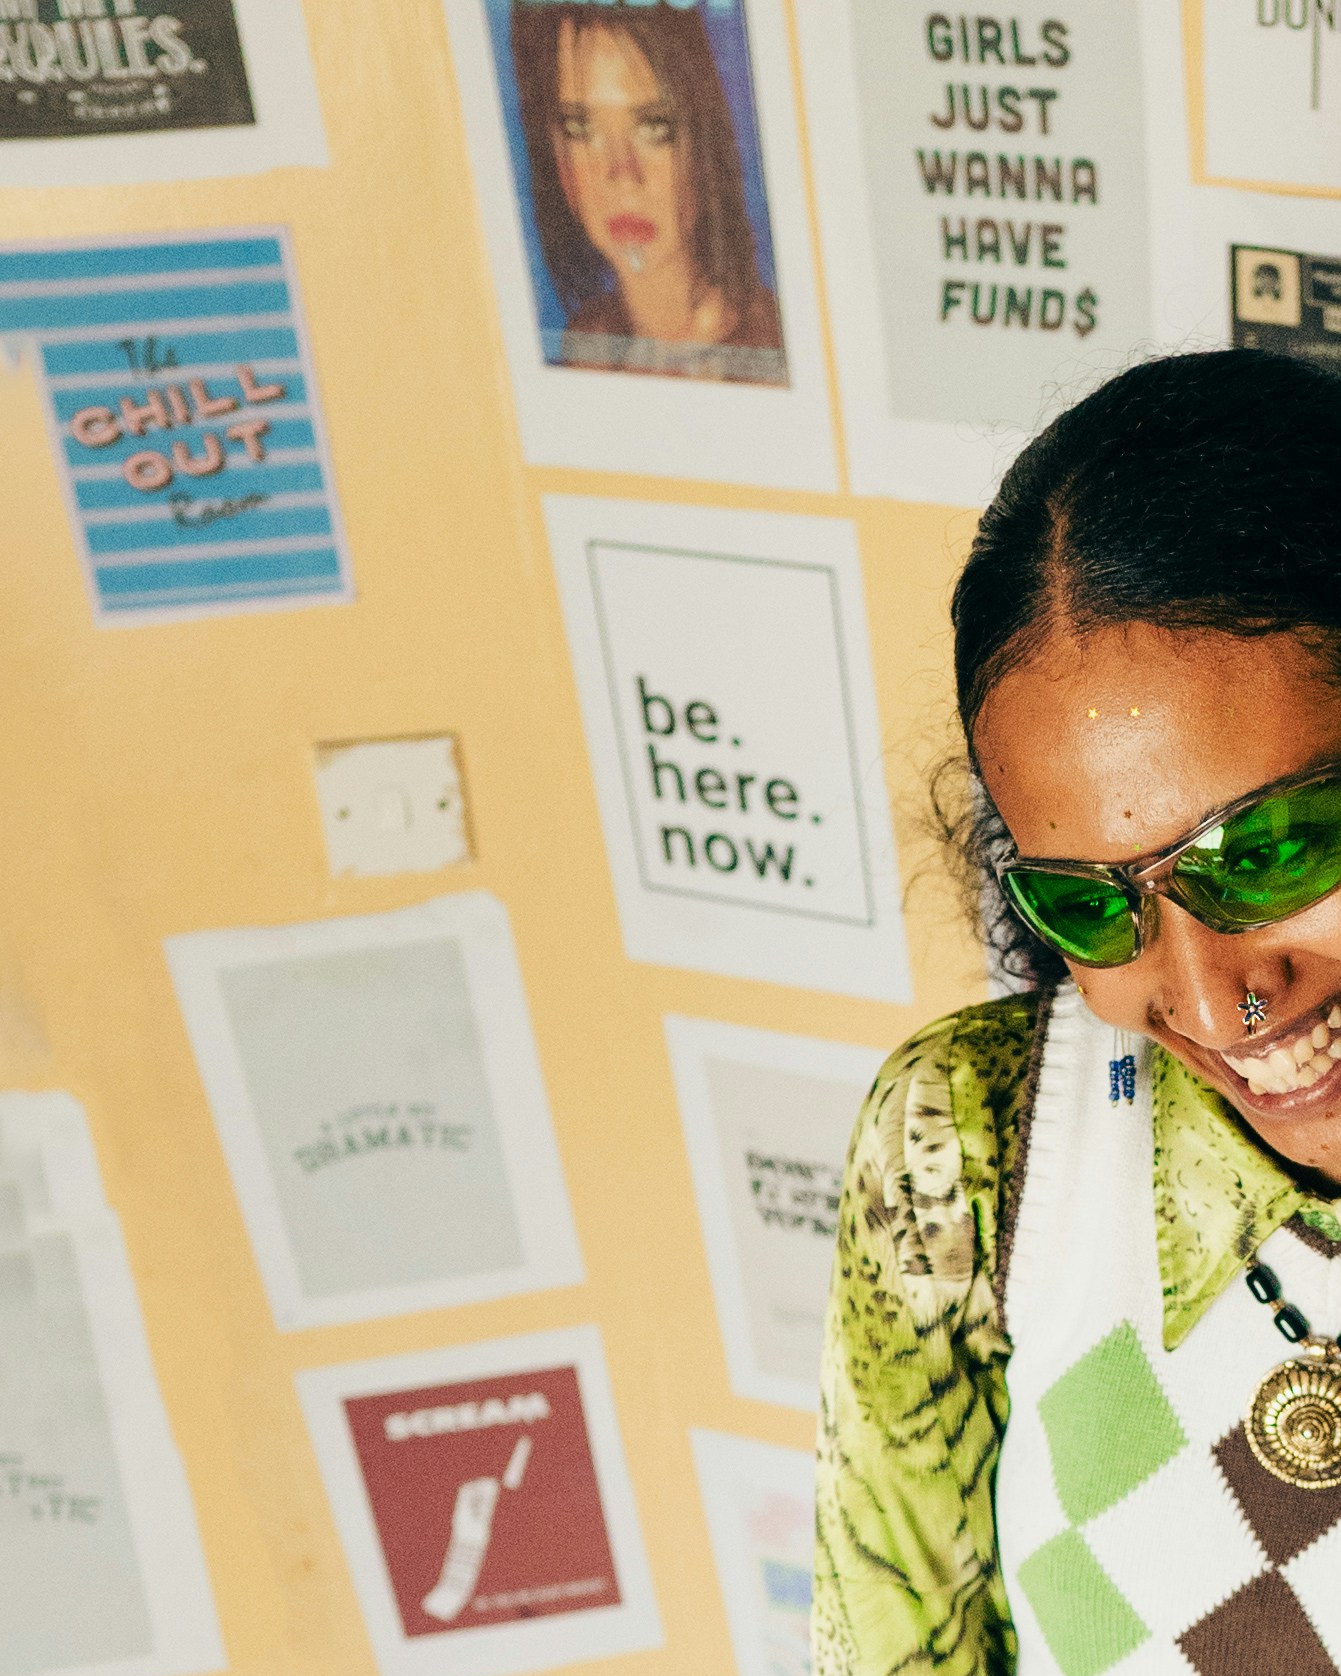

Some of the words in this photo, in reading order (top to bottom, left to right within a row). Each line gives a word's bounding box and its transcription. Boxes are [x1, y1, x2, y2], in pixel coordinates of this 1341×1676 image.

[926, 12, 1072, 67] GIRLS
[929, 82, 1059, 135] JUST
[916, 148, 1098, 205] WANNA
[941, 215, 1066, 268] HAVE
[940, 280, 1098, 338] FUND$
[70, 364, 286, 448] CHILL
[121, 420, 272, 492] OUT
[635, 674, 741, 743] be.
[647, 742, 823, 826] here.
[660, 824, 814, 884] now.
